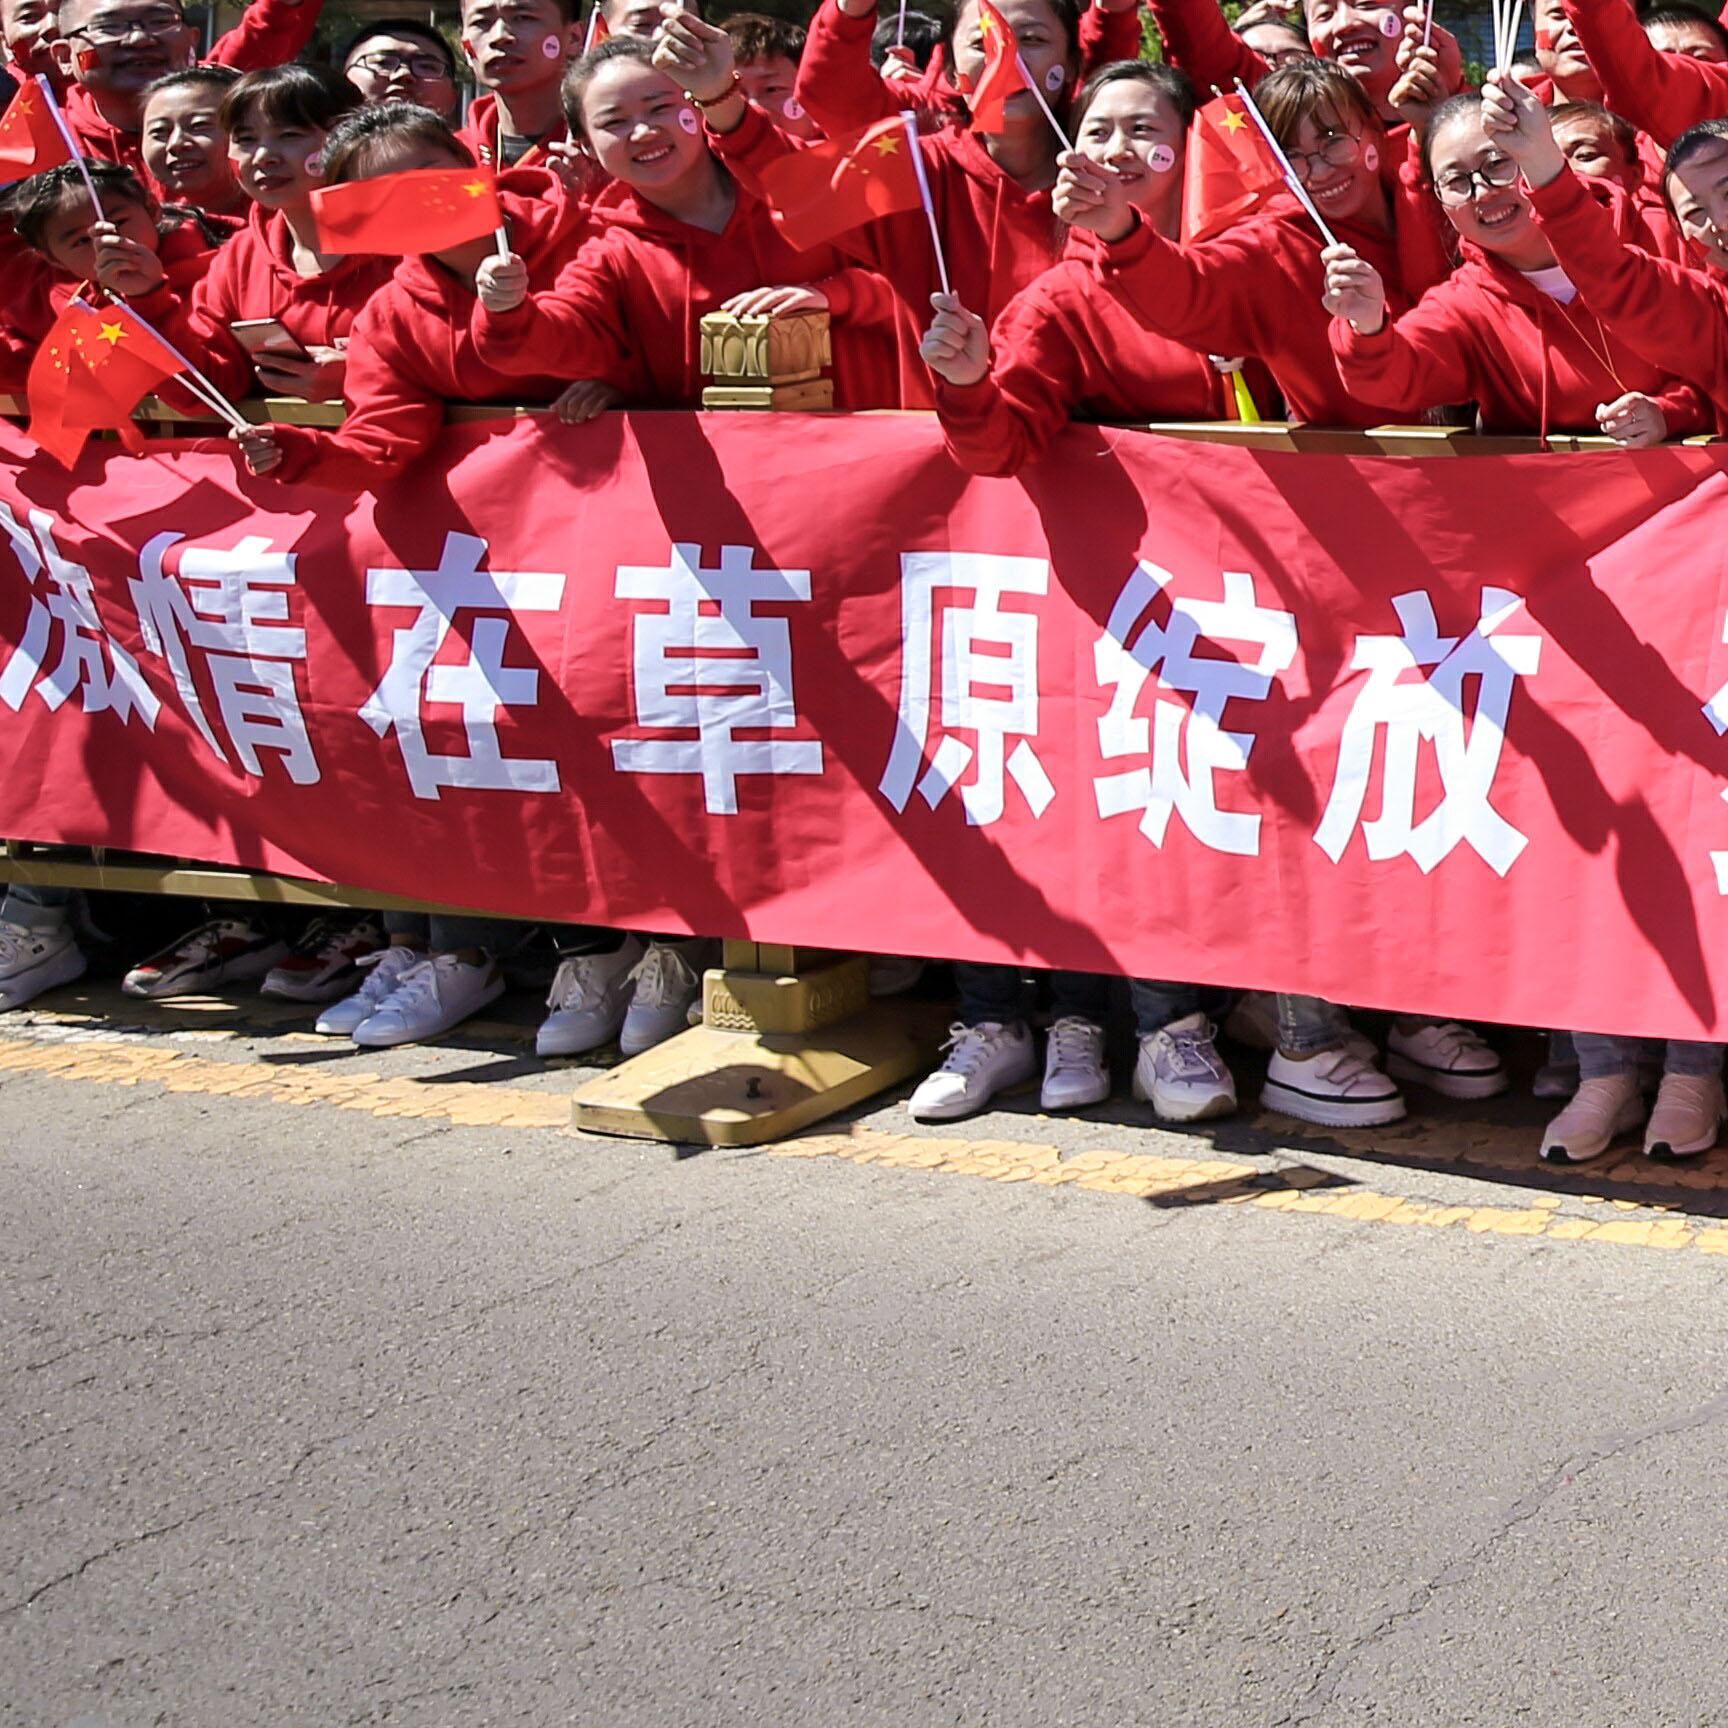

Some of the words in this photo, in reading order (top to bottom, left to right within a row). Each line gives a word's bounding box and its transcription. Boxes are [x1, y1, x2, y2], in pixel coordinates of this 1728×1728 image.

[0, 500, 1541, 878] 激情在草原绽放
